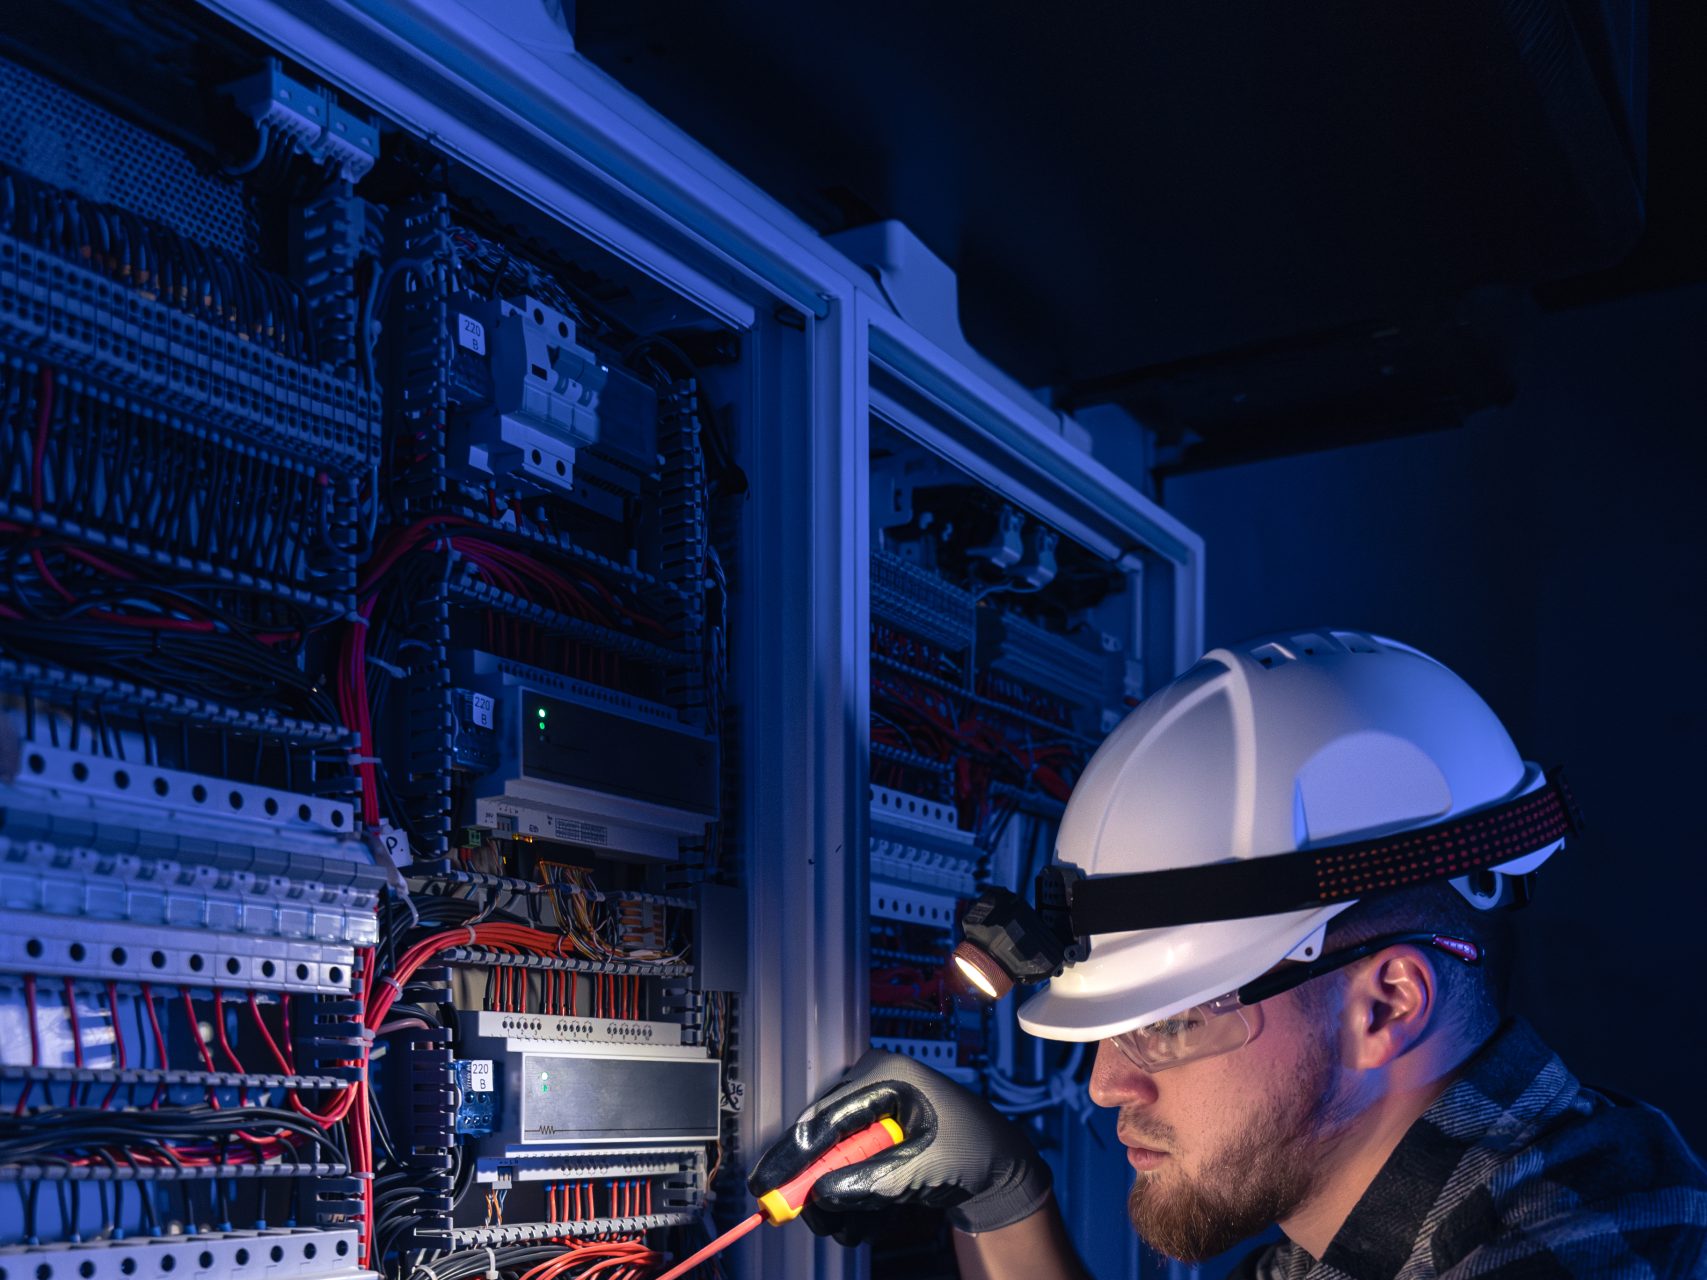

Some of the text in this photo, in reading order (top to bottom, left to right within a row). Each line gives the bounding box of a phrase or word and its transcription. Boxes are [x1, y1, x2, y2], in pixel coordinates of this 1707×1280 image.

[464, 319, 481, 337] 220
[472, 338, 479, 351] B
[474, 696, 491, 711] 220
[481, 713, 488, 725] B
[472, 1063, 489, 1075] 220
[479, 1078, 487, 1090] B
